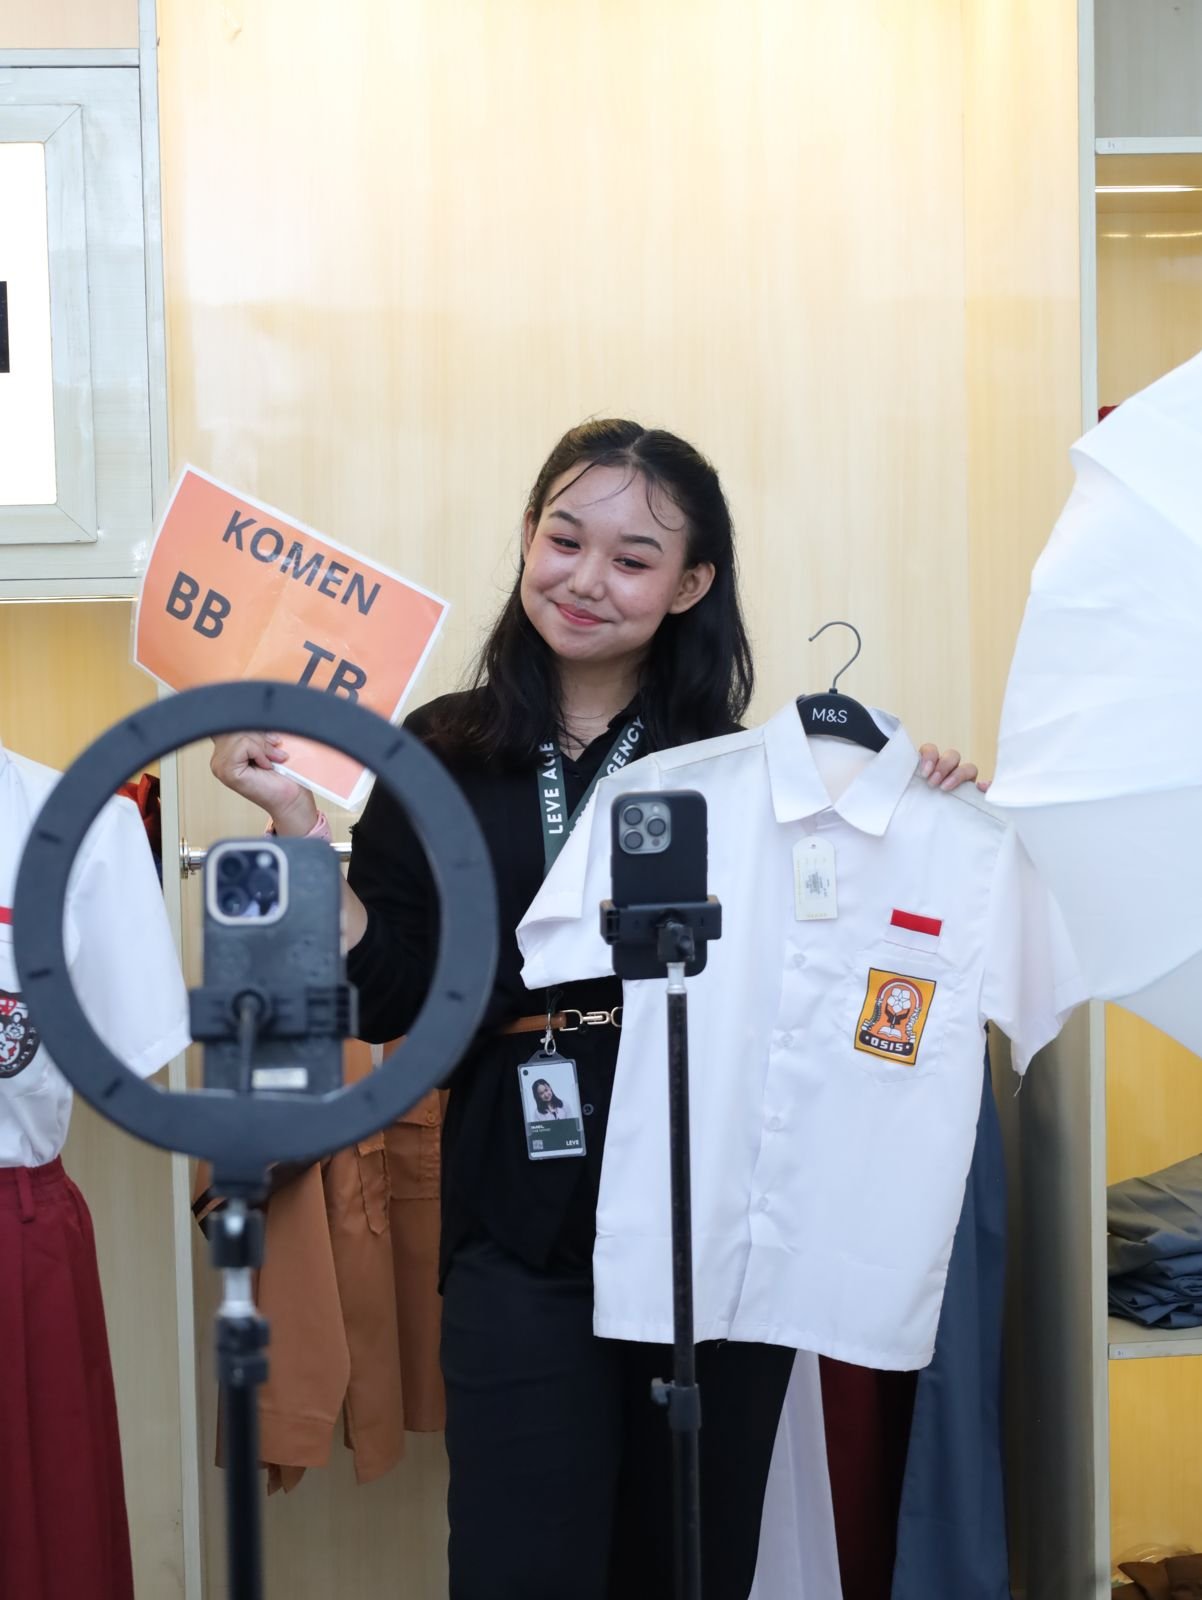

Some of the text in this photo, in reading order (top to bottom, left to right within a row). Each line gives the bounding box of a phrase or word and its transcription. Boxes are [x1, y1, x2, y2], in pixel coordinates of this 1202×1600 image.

[222, 510, 381, 615] KOMEN
[165, 571, 231, 638] BB
[297, 640, 367, 703] TB
[606, 715, 644, 776] GENCY
[812, 707, 848, 723] M&S
[544, 788, 563, 834] LEVE
[870, 1037, 903, 1051] OSIS
